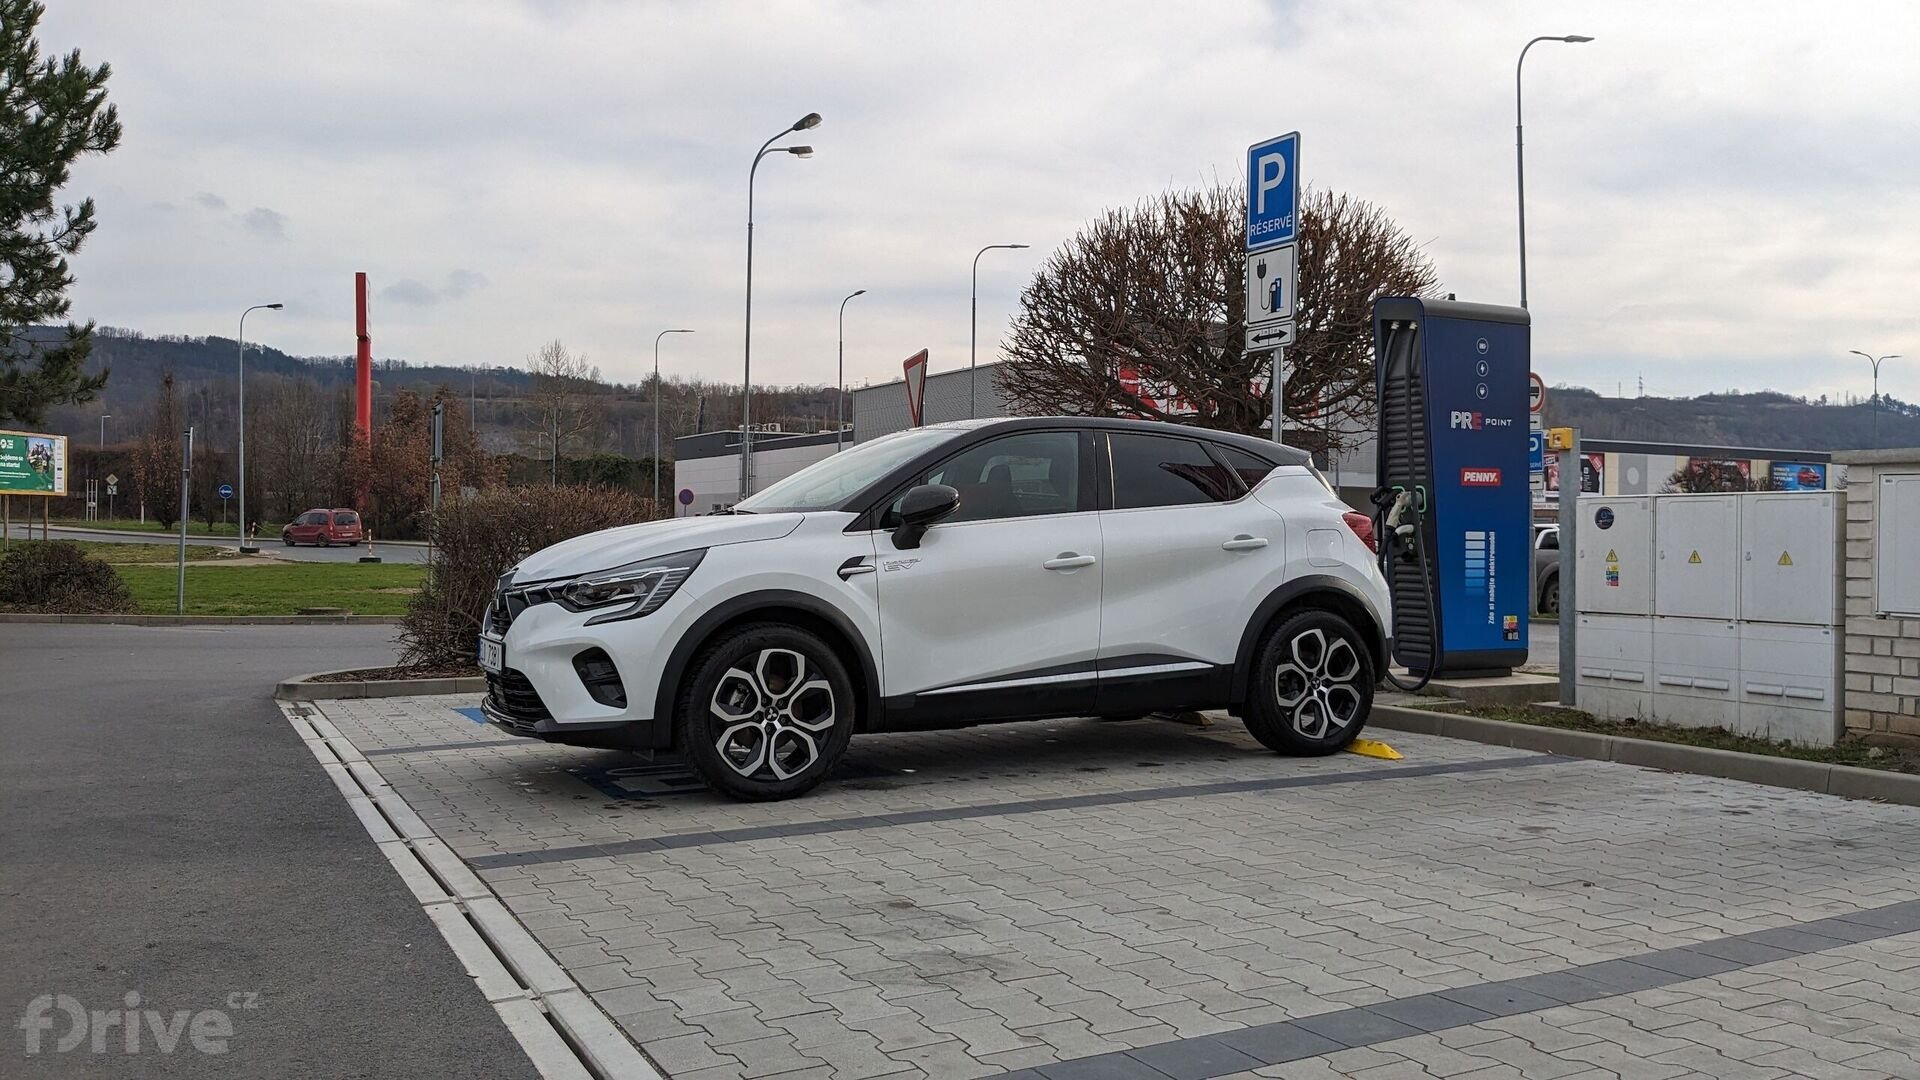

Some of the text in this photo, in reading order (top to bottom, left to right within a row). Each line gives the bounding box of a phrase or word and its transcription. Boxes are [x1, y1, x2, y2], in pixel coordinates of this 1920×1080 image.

[1257, 152, 1285, 215] P
[1250, 211, 1292, 236] RÉSERVÉ
[1450, 410, 1512, 430] PRE POINT
